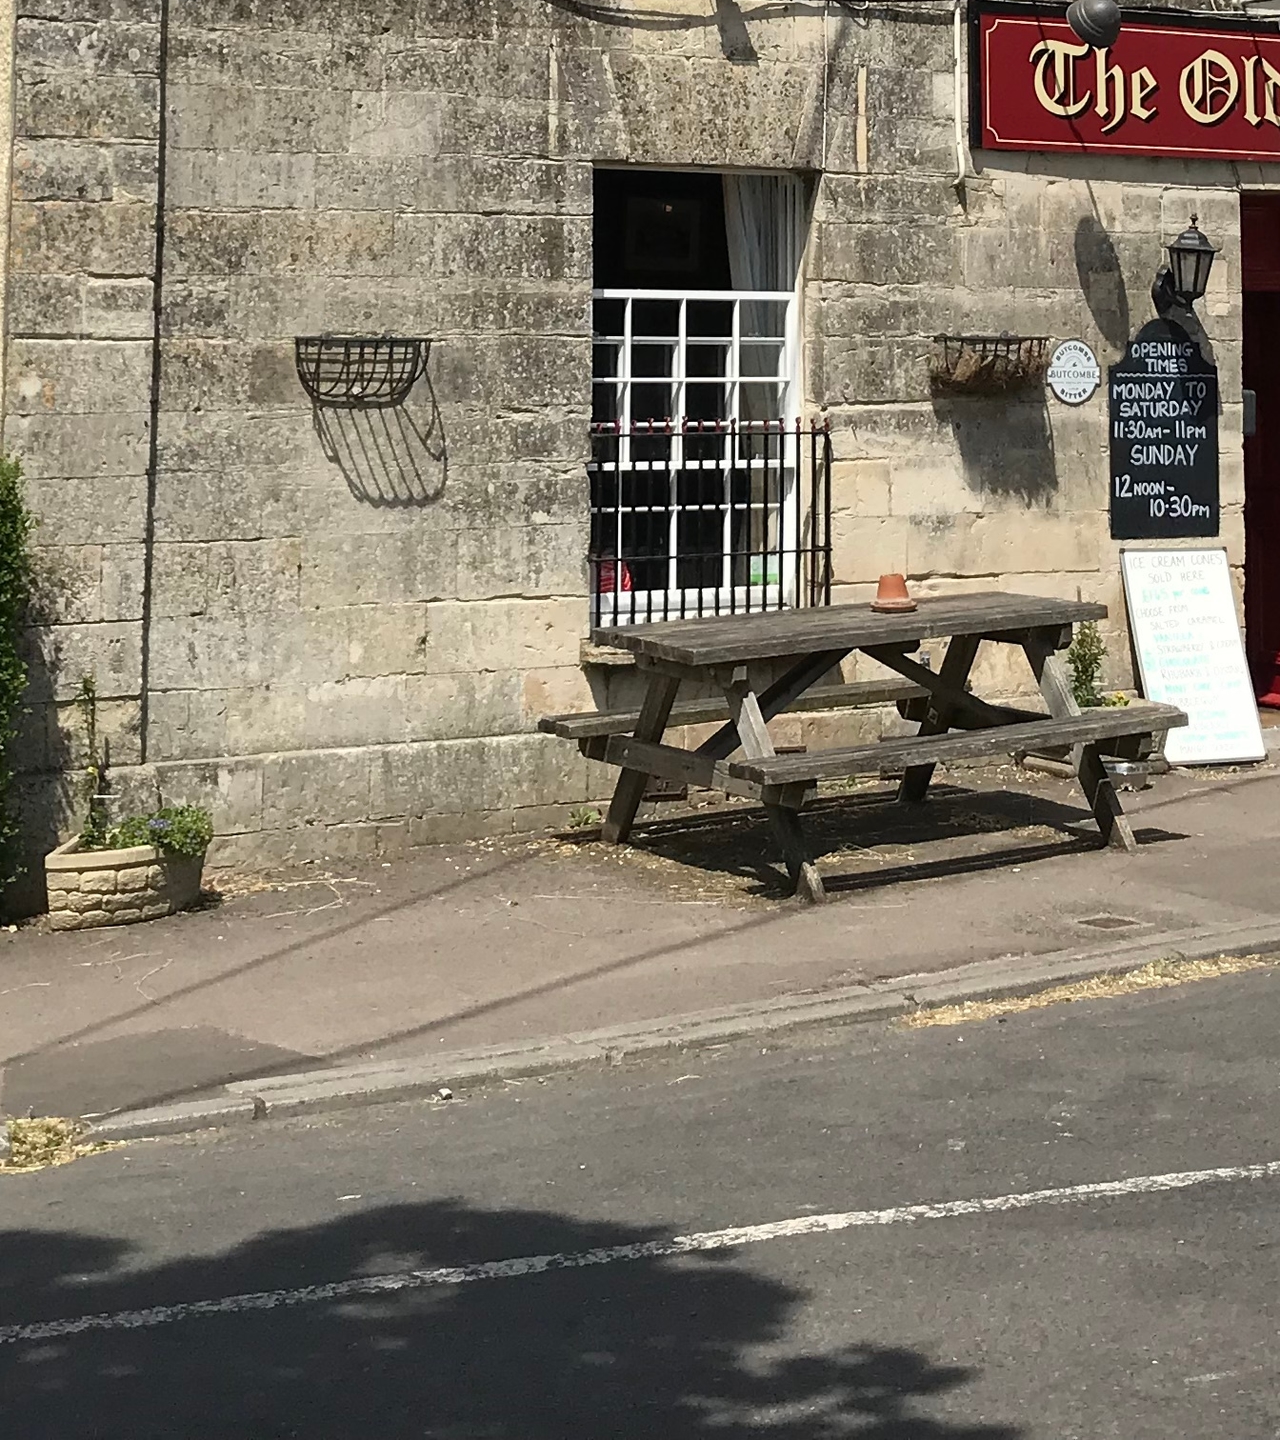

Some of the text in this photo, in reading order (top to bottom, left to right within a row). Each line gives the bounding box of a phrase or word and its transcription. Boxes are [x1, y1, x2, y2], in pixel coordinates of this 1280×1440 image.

[1030, 39, 1158, 133] The
[1056, 345, 1091, 362] BUTCOMBE
[1131, 342, 1193, 358] OPENING
[1145, 358, 1188, 373] TIMES
[1050, 370, 1096, 378] BUTCOMBE
[1113, 381, 1206, 400] MONDAY TO
[1120, 400, 1202, 418] SATURDAY
[1175, 421, 1206, 439] 11PM
[1130, 444, 1198, 466] SUNDAY
[1129, 553, 1222, 569] ICE CREAM CONES
[1148, 570, 1205, 584] SOLD HERE
[1169, 604, 1188, 615] FROM
